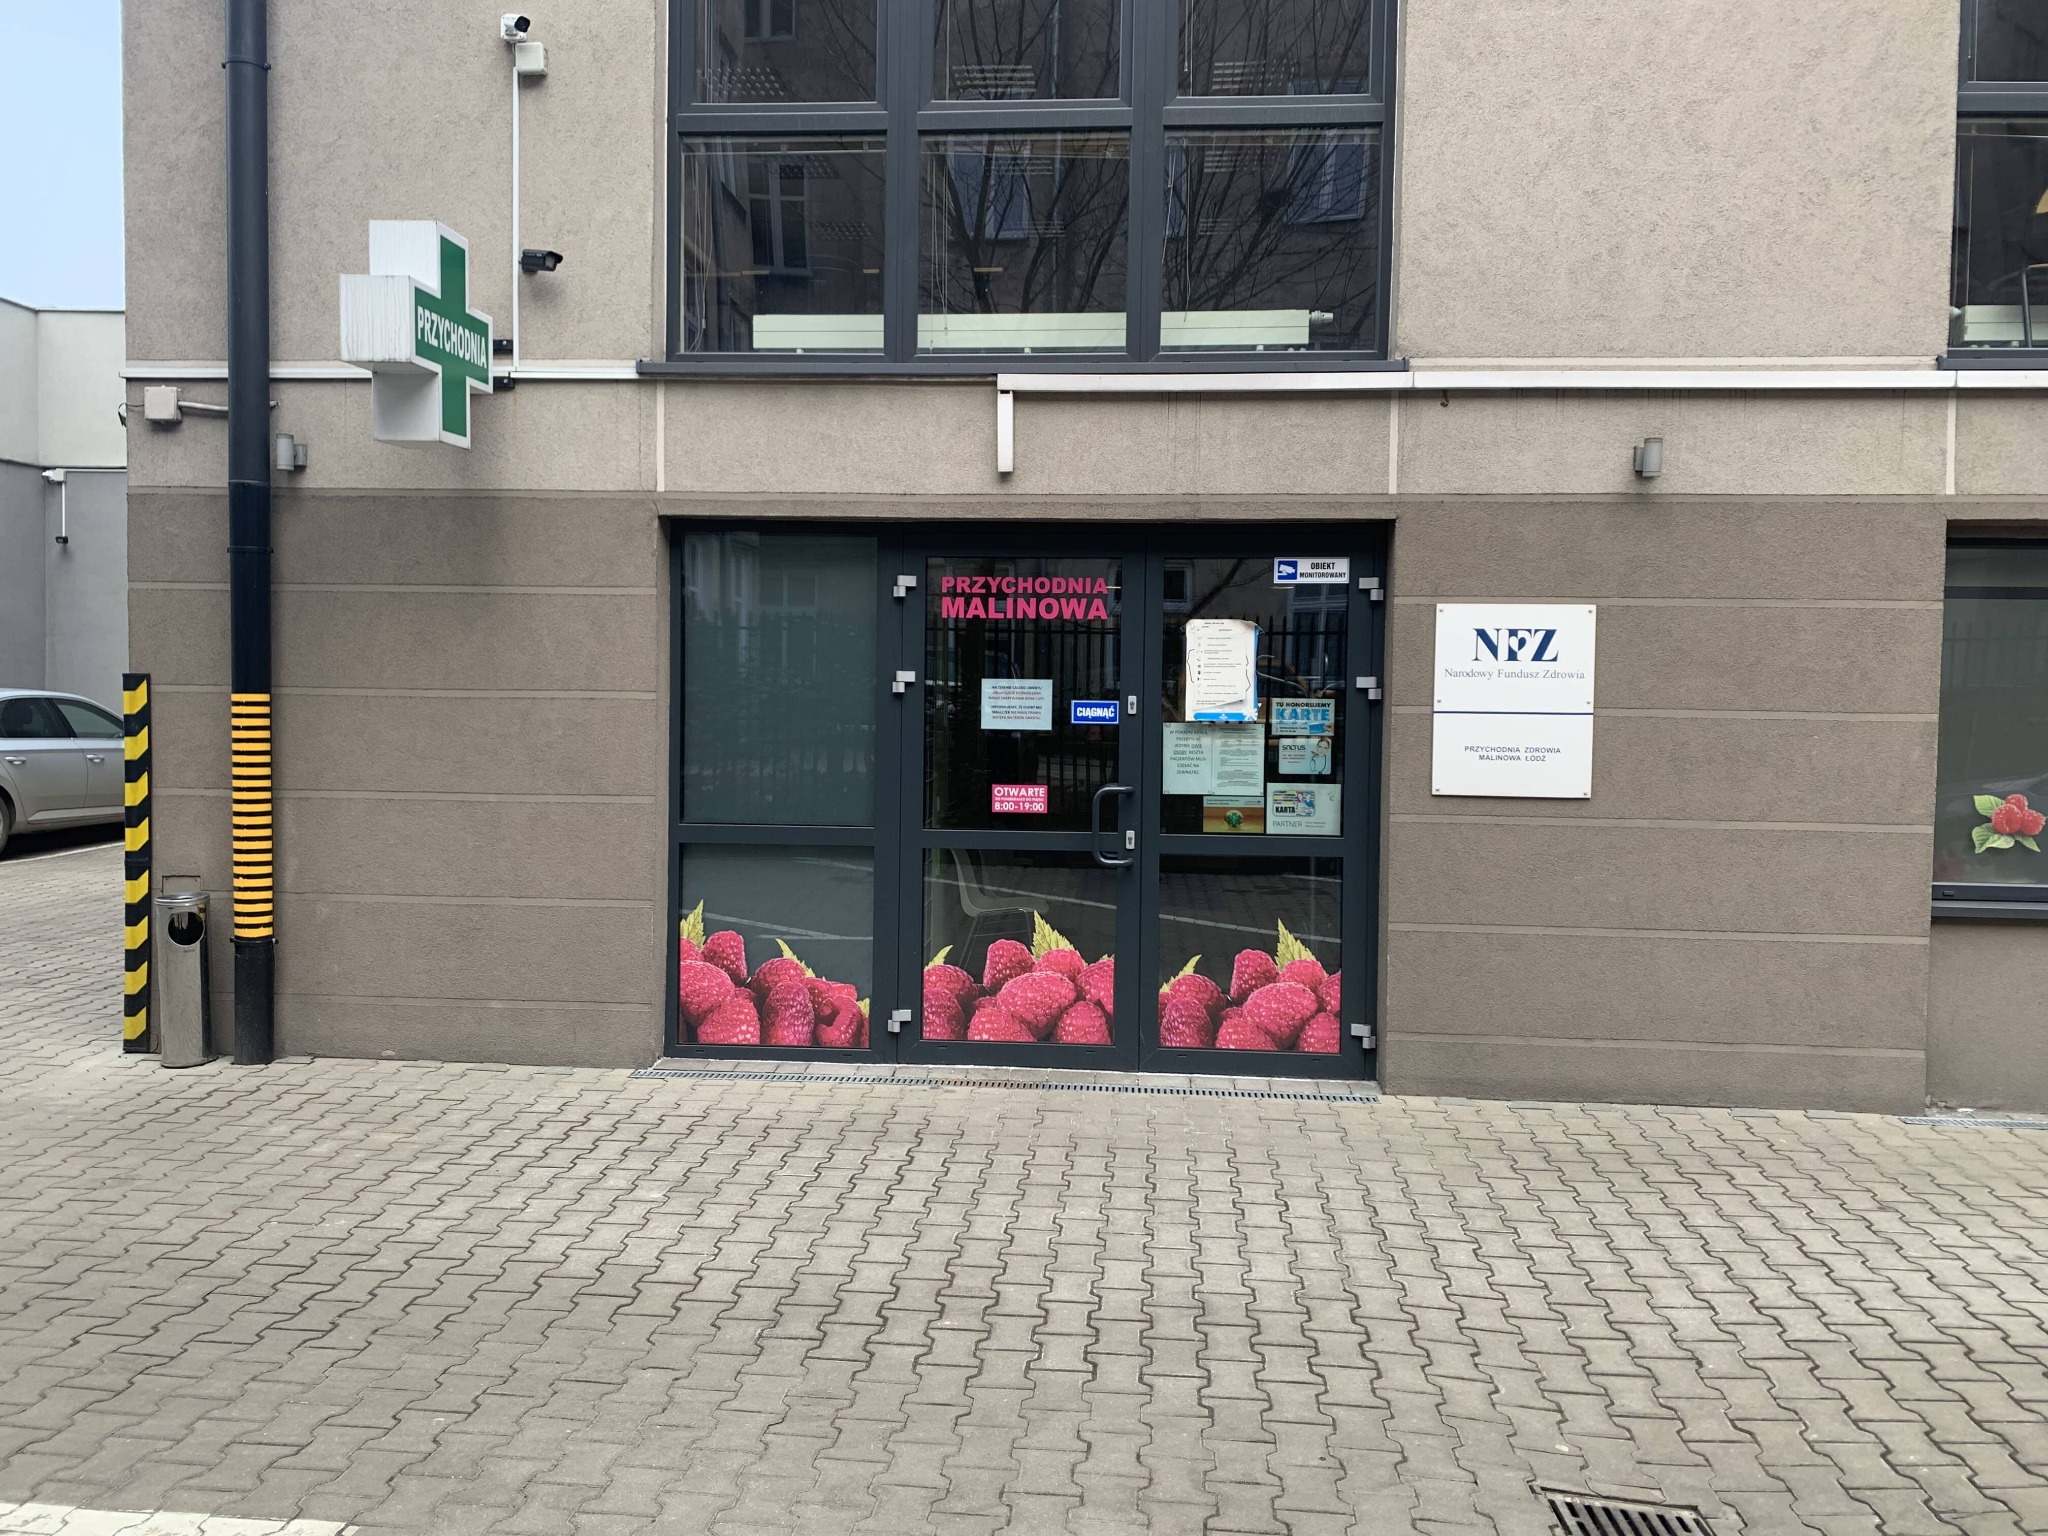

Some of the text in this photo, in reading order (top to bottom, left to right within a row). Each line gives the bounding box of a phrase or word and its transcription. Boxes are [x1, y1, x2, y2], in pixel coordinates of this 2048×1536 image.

[417, 305, 487, 369] PRZYCHODNIA
[1310, 562, 1335, 570] OBIEKT
[941, 576, 1108, 594] PRZYCHODNIA
[941, 597, 1108, 620] MALINOWA
[1471, 628, 1560, 662] NFZ
[1444, 668, 1585, 680] Narodowy Fundusz Zdrowia
[1076, 705, 1115, 719] CIĄGNĄĆ
[1524, 746, 1561, 754] ZDROWIA
[1525, 754, 1547, 762] ŁÓDŹ
[994, 787, 1045, 797] OTWARTE
[994, 802, 1045, 811] 8:00-19:00
[1275, 806, 1296, 814] KARTA
